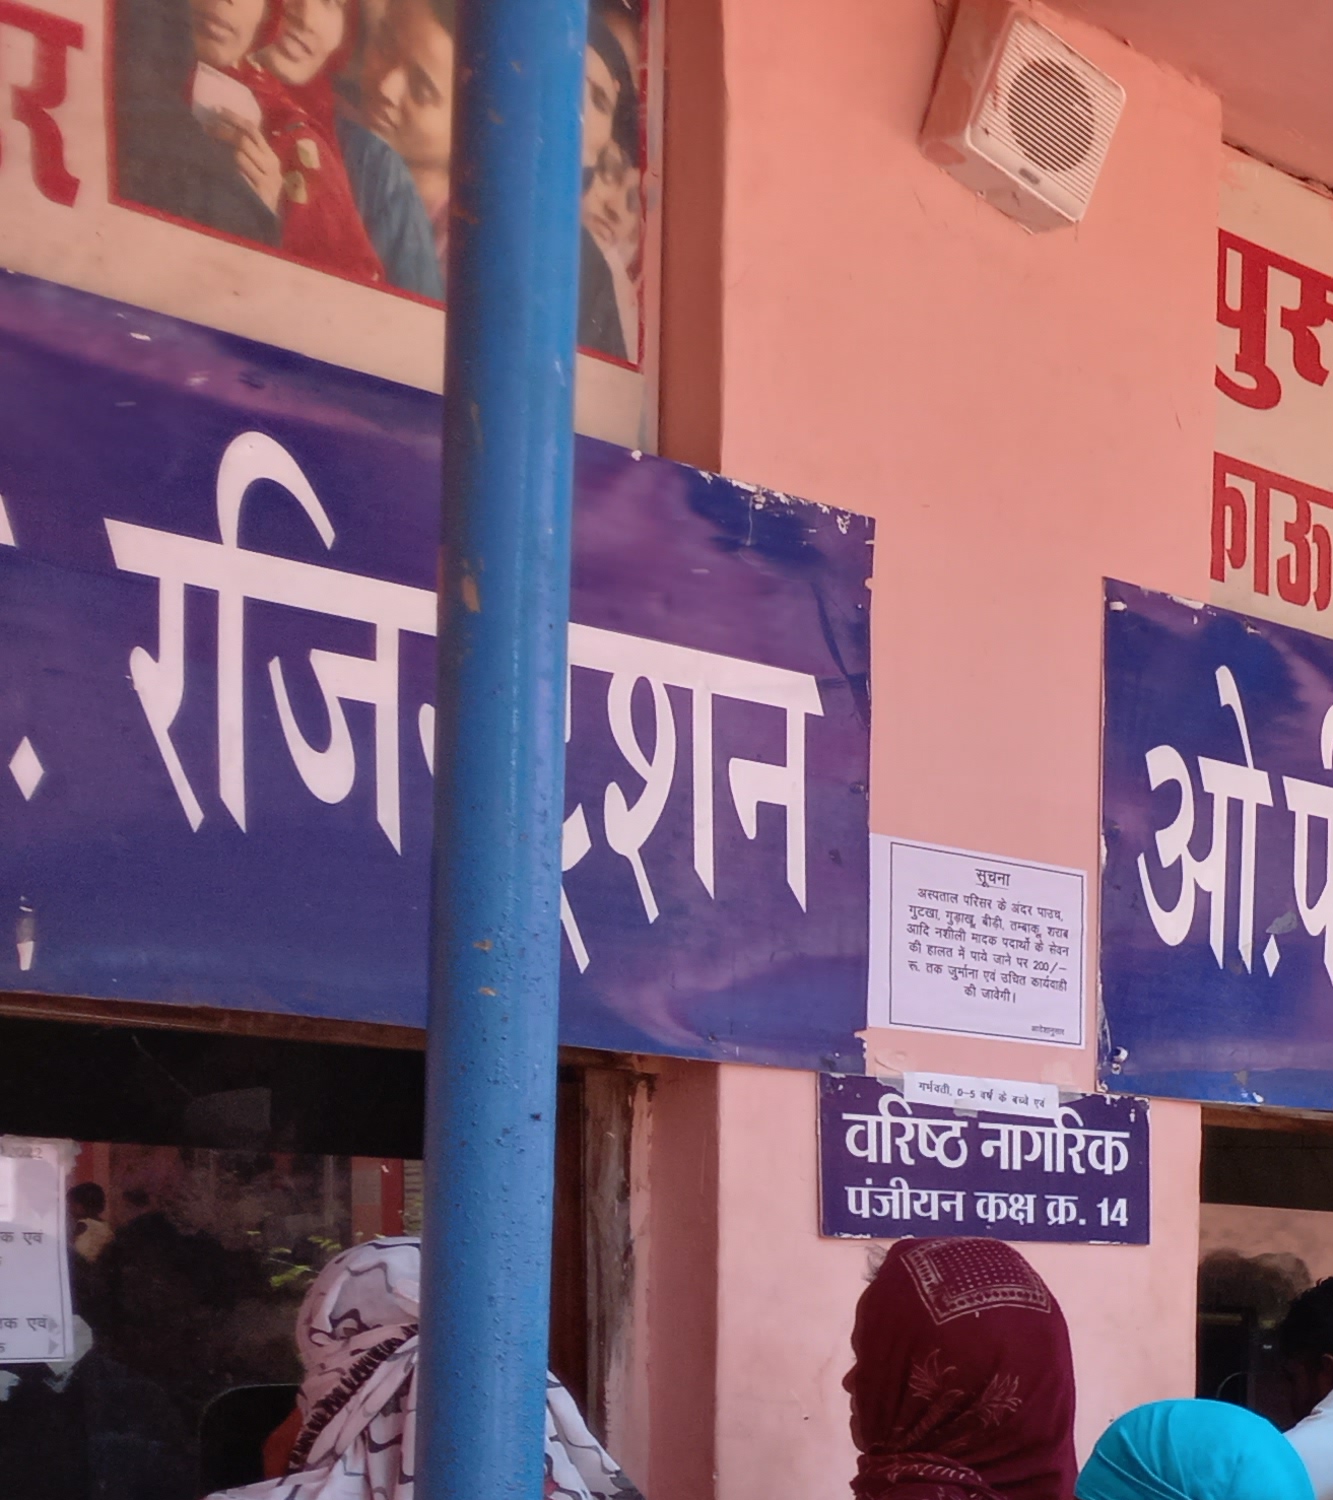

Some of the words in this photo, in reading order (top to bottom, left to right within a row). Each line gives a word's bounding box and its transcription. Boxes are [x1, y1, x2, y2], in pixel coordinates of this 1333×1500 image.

[975, 868, 1010, 887] सूचना
[918, 888, 958, 904] अस्पताल
[963, 893, 992, 909] परिसर
[997, 898, 1006, 911] के
[1011, 901, 1033, 916] अंदर
[907, 923, 929, 937] आदि
[935, 927, 966, 942] नशीली
[971, 934, 997, 946] मादक
[1034, 940, 1044, 952] के
[1049, 942, 1069, 957] सेवन
[1047, 926, 1069, 939] शराब
[909, 941, 922, 954] की
[927, 944, 953, 957] हालत
[958, 946, 966, 960] में
[970, 950, 988, 962] पाये
[993, 952, 1011, 966] जाने
[1016, 958, 1028, 968] पर
[926, 962, 943, 974] तक
[949, 963, 979, 981] जुर्माना
[983, 968, 996, 983] एवं
[1001, 971, 1026, 986] उचित
[1031, 975, 1068, 992] कार्यवाही
[964, 984, 976, 997] की
[980, 1088, 994, 1101] वर्ष
[998, 1091, 1007, 1103] के
[1011, 1094, 1029, 1107] बच्चे
[1033, 1097, 1046, 1109] एवं
[842, 1093, 968, 1168] वरिष्ठ
[978, 1106, 1130, 1174] नागरिक
[845, 1177, 966, 1221] पंजीयन
[974, 1191, 1037, 1225] कक्ष
[1045, 1194, 1086, 1226] क्र.
[1097, 1198, 1129, 1227] 14
[21, 1229, 44, 1245] एवं
[28, 1315, 48, 1330] एवं
